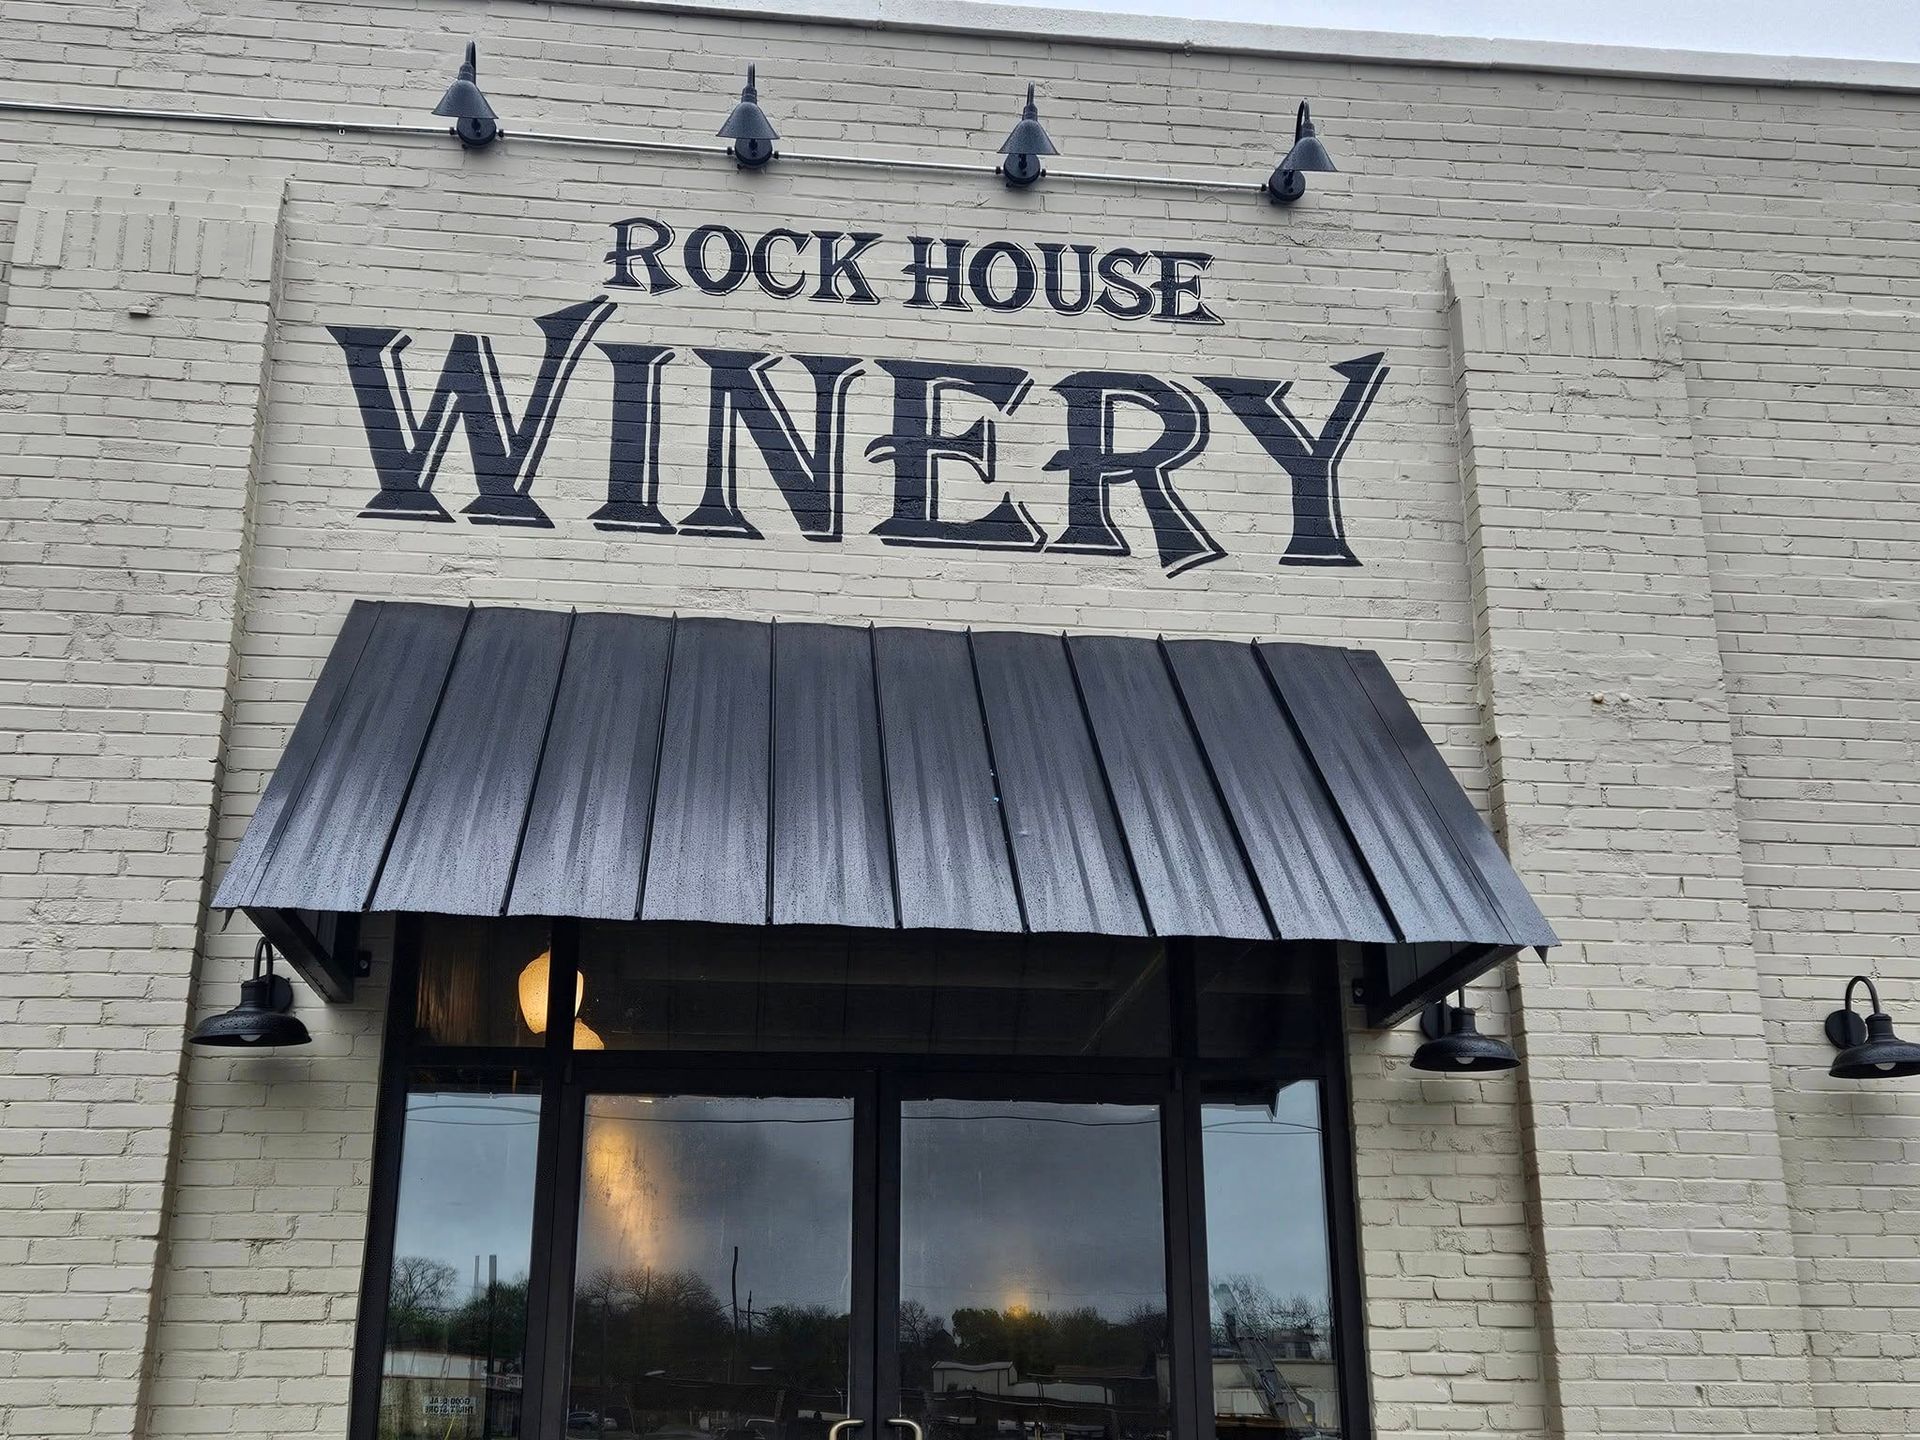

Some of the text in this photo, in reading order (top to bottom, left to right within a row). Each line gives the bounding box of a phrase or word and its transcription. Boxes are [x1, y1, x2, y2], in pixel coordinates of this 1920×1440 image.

[602, 217, 1226, 326] ROCK HOUSE
[326, 294, 1389, 577] WINERY
